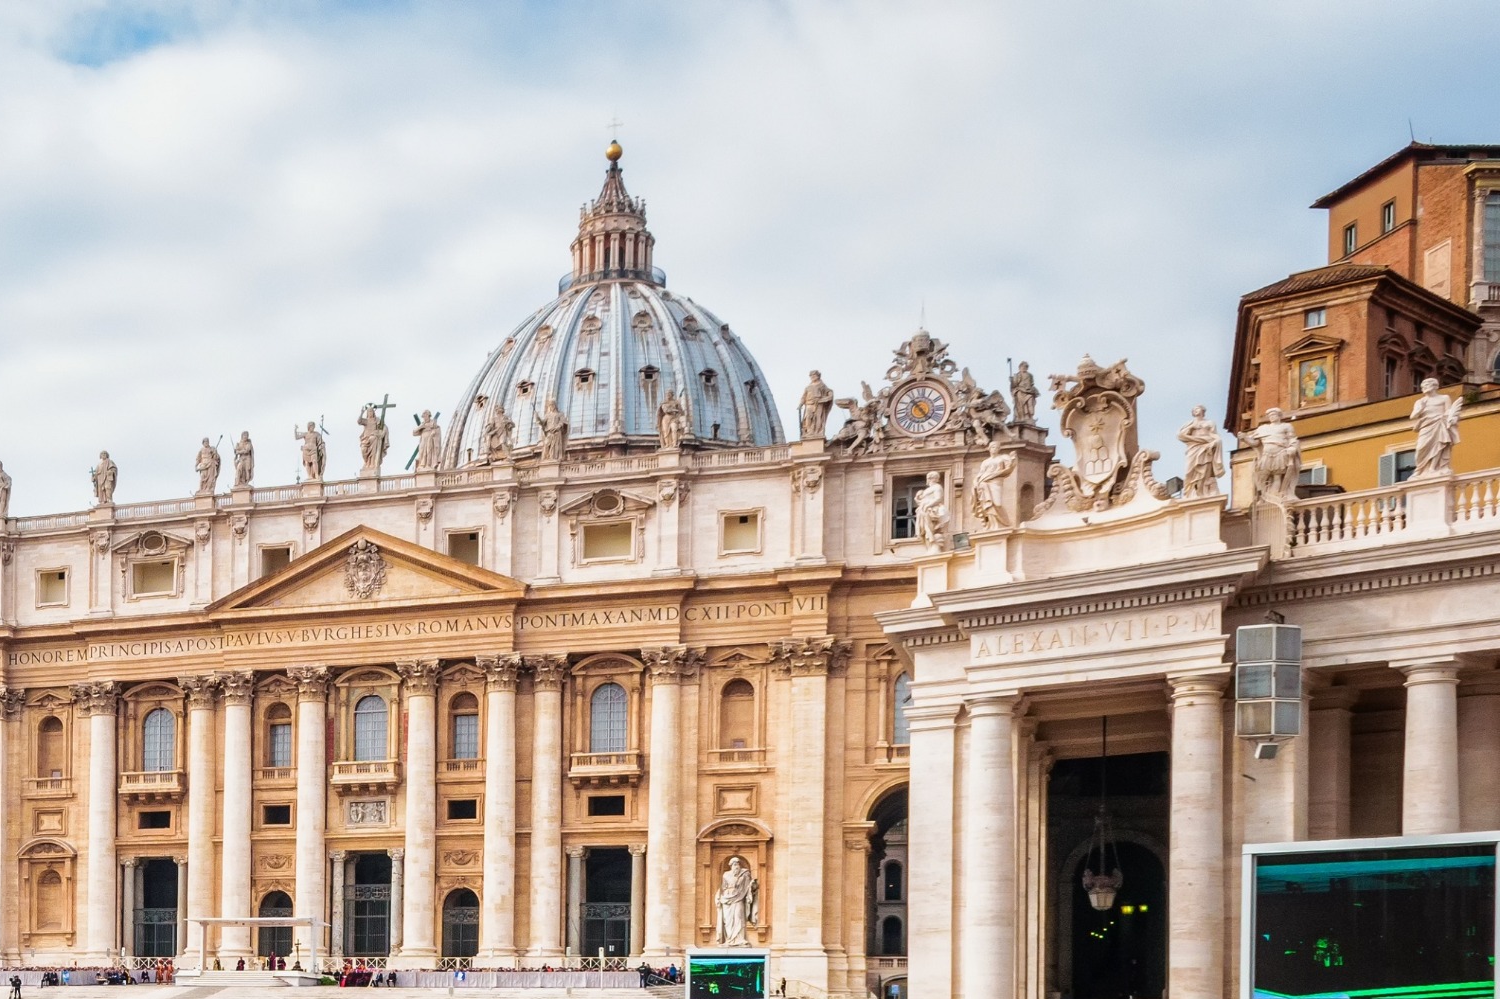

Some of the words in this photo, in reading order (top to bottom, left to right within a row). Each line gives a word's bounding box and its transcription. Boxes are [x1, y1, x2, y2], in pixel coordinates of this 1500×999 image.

[8, 649, 88, 666] HONOREM
[90, 639, 172, 660] PRINCIPIS
[174, 636, 225, 653] APOST
[417, 614, 512, 635] ROMANVS
[975, 625, 1088, 659] ALEXAN
